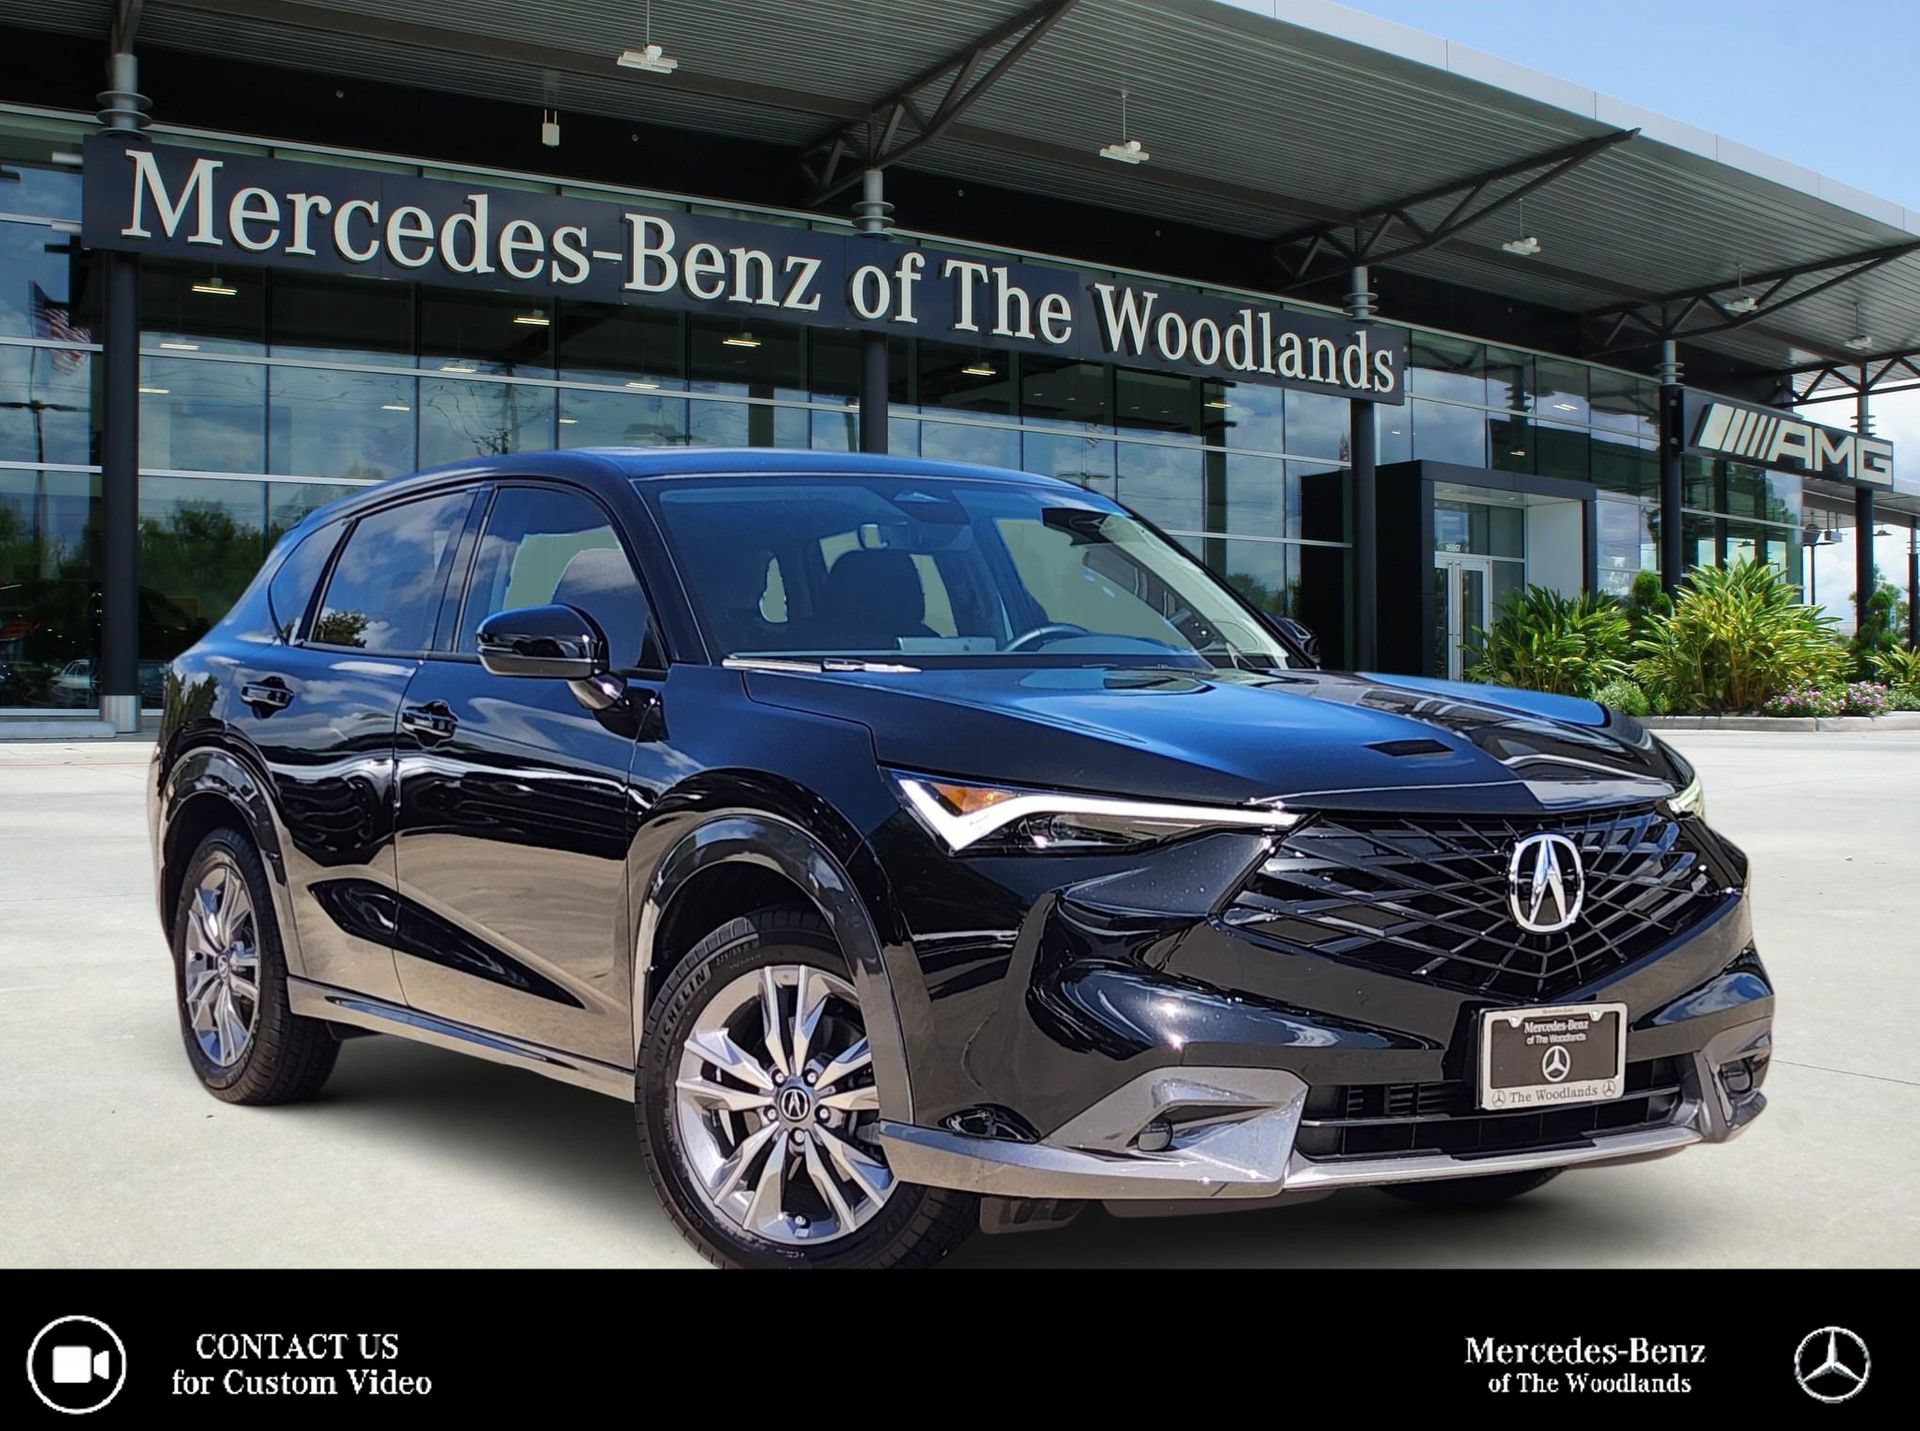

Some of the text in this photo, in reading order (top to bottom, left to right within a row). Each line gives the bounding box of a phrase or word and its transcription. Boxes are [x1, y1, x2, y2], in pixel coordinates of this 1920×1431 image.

[121, 149, 1395, 393] Mercedes-Benz of The Woodlands
[655, 967, 708, 1064] MICHELIN
[1524, 1019, 1588, 1033] Mercedes-Benz
[1526, 1032, 1586, 1045] of The Woodlands
[1510, 1085, 1598, 1104] The Woodlands
